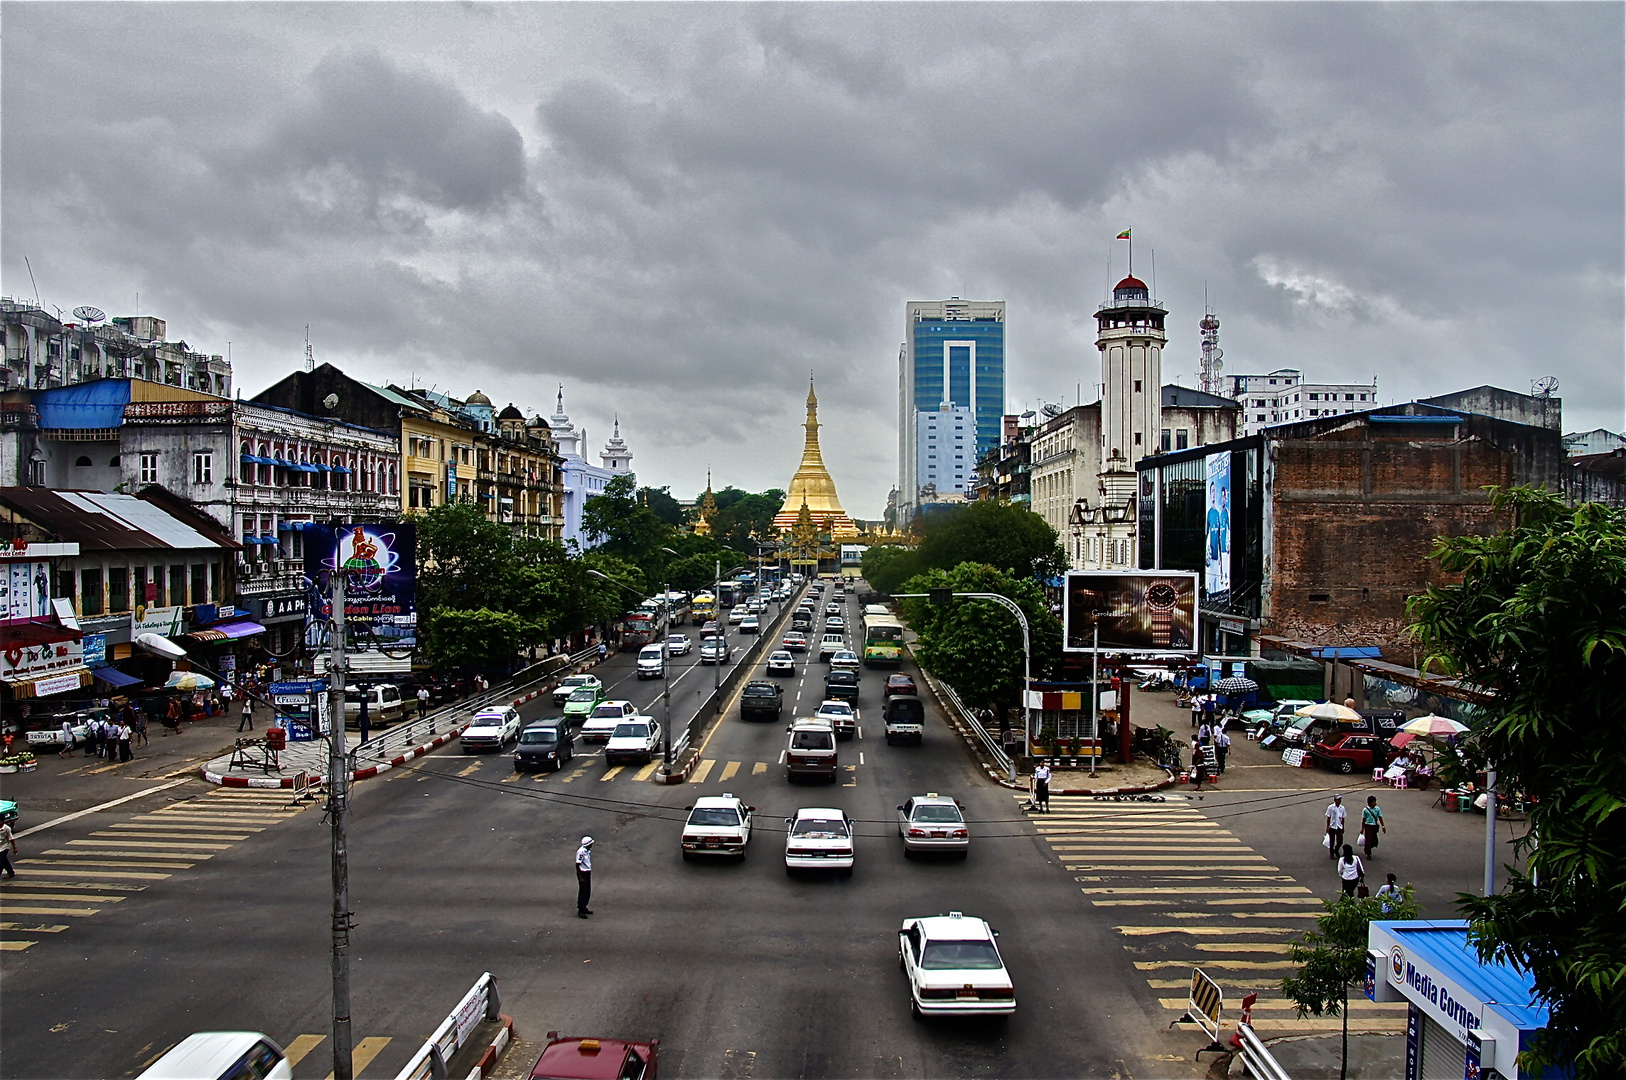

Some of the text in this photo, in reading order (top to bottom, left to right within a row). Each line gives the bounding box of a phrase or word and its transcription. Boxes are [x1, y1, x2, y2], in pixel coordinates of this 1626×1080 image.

[371, 603, 402, 614] Lion
[1406, 961, 1437, 1006] Media
[1439, 987, 1480, 1029] Corner
